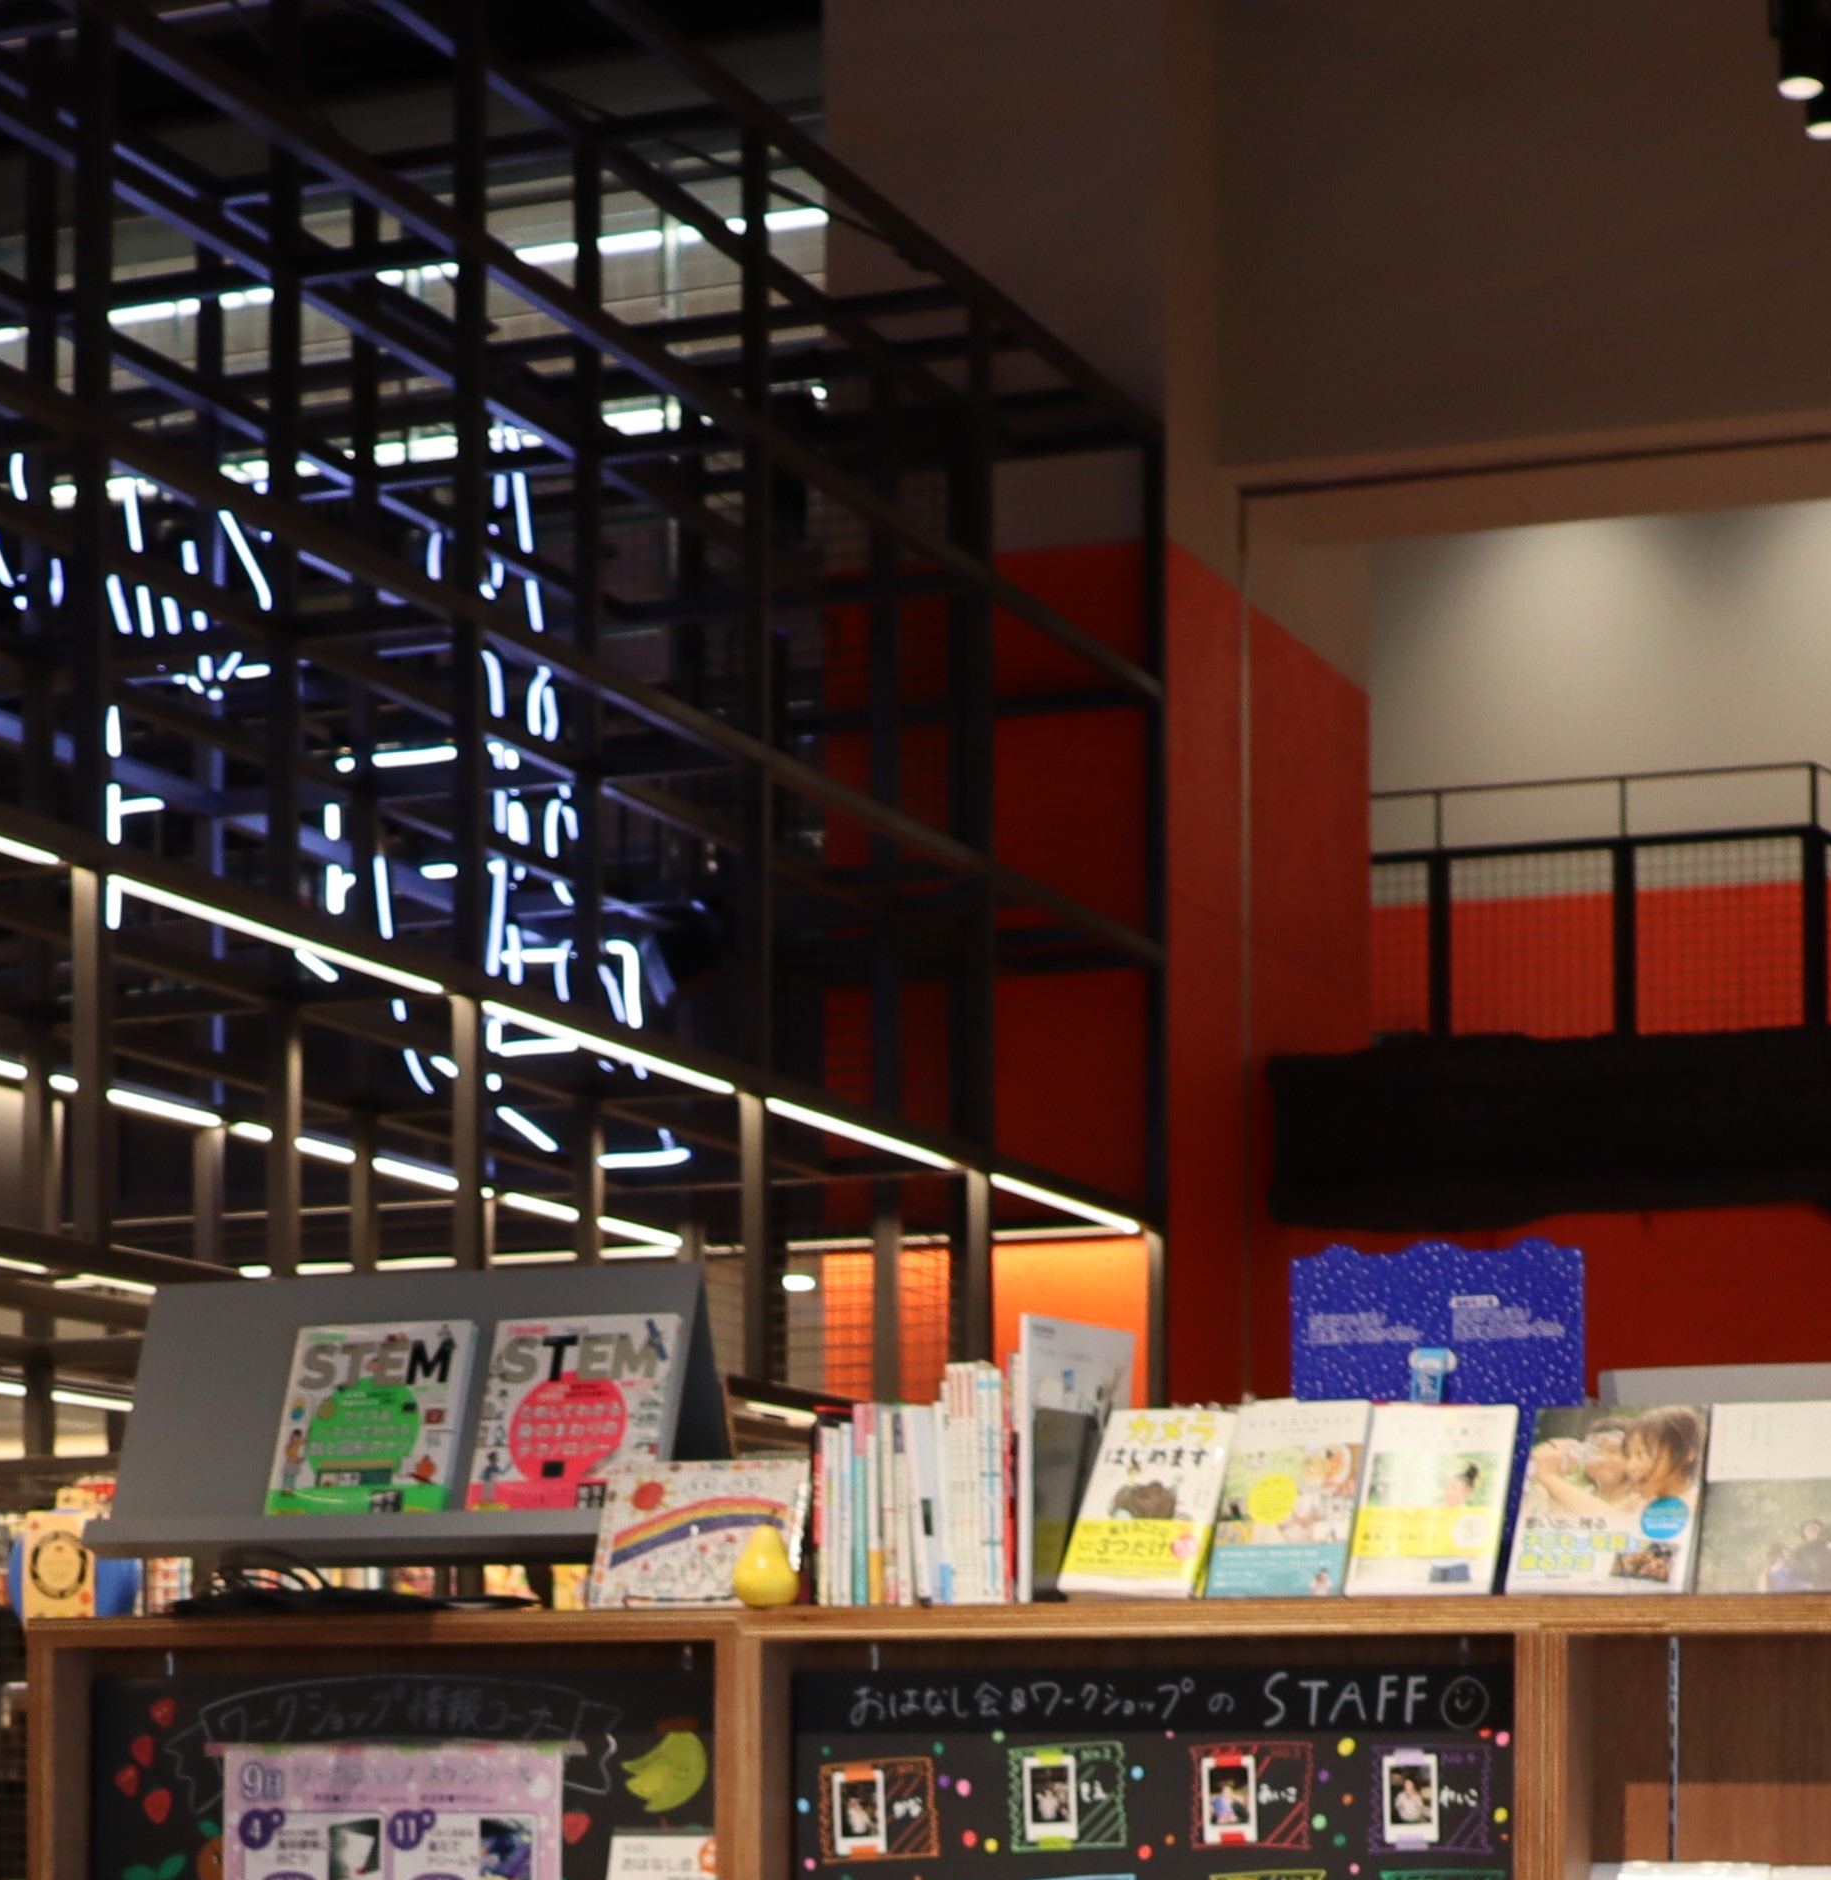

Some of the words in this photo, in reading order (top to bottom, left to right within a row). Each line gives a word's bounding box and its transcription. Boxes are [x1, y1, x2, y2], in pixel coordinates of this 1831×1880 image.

[298, 1337, 455, 1390] STEM
[498, 1333, 659, 1383] STEM
[1128, 1415, 1215, 1445] カメラ
[1105, 1447, 1207, 1468] はじめます
[1263, 1673, 1427, 1729] STAFF
